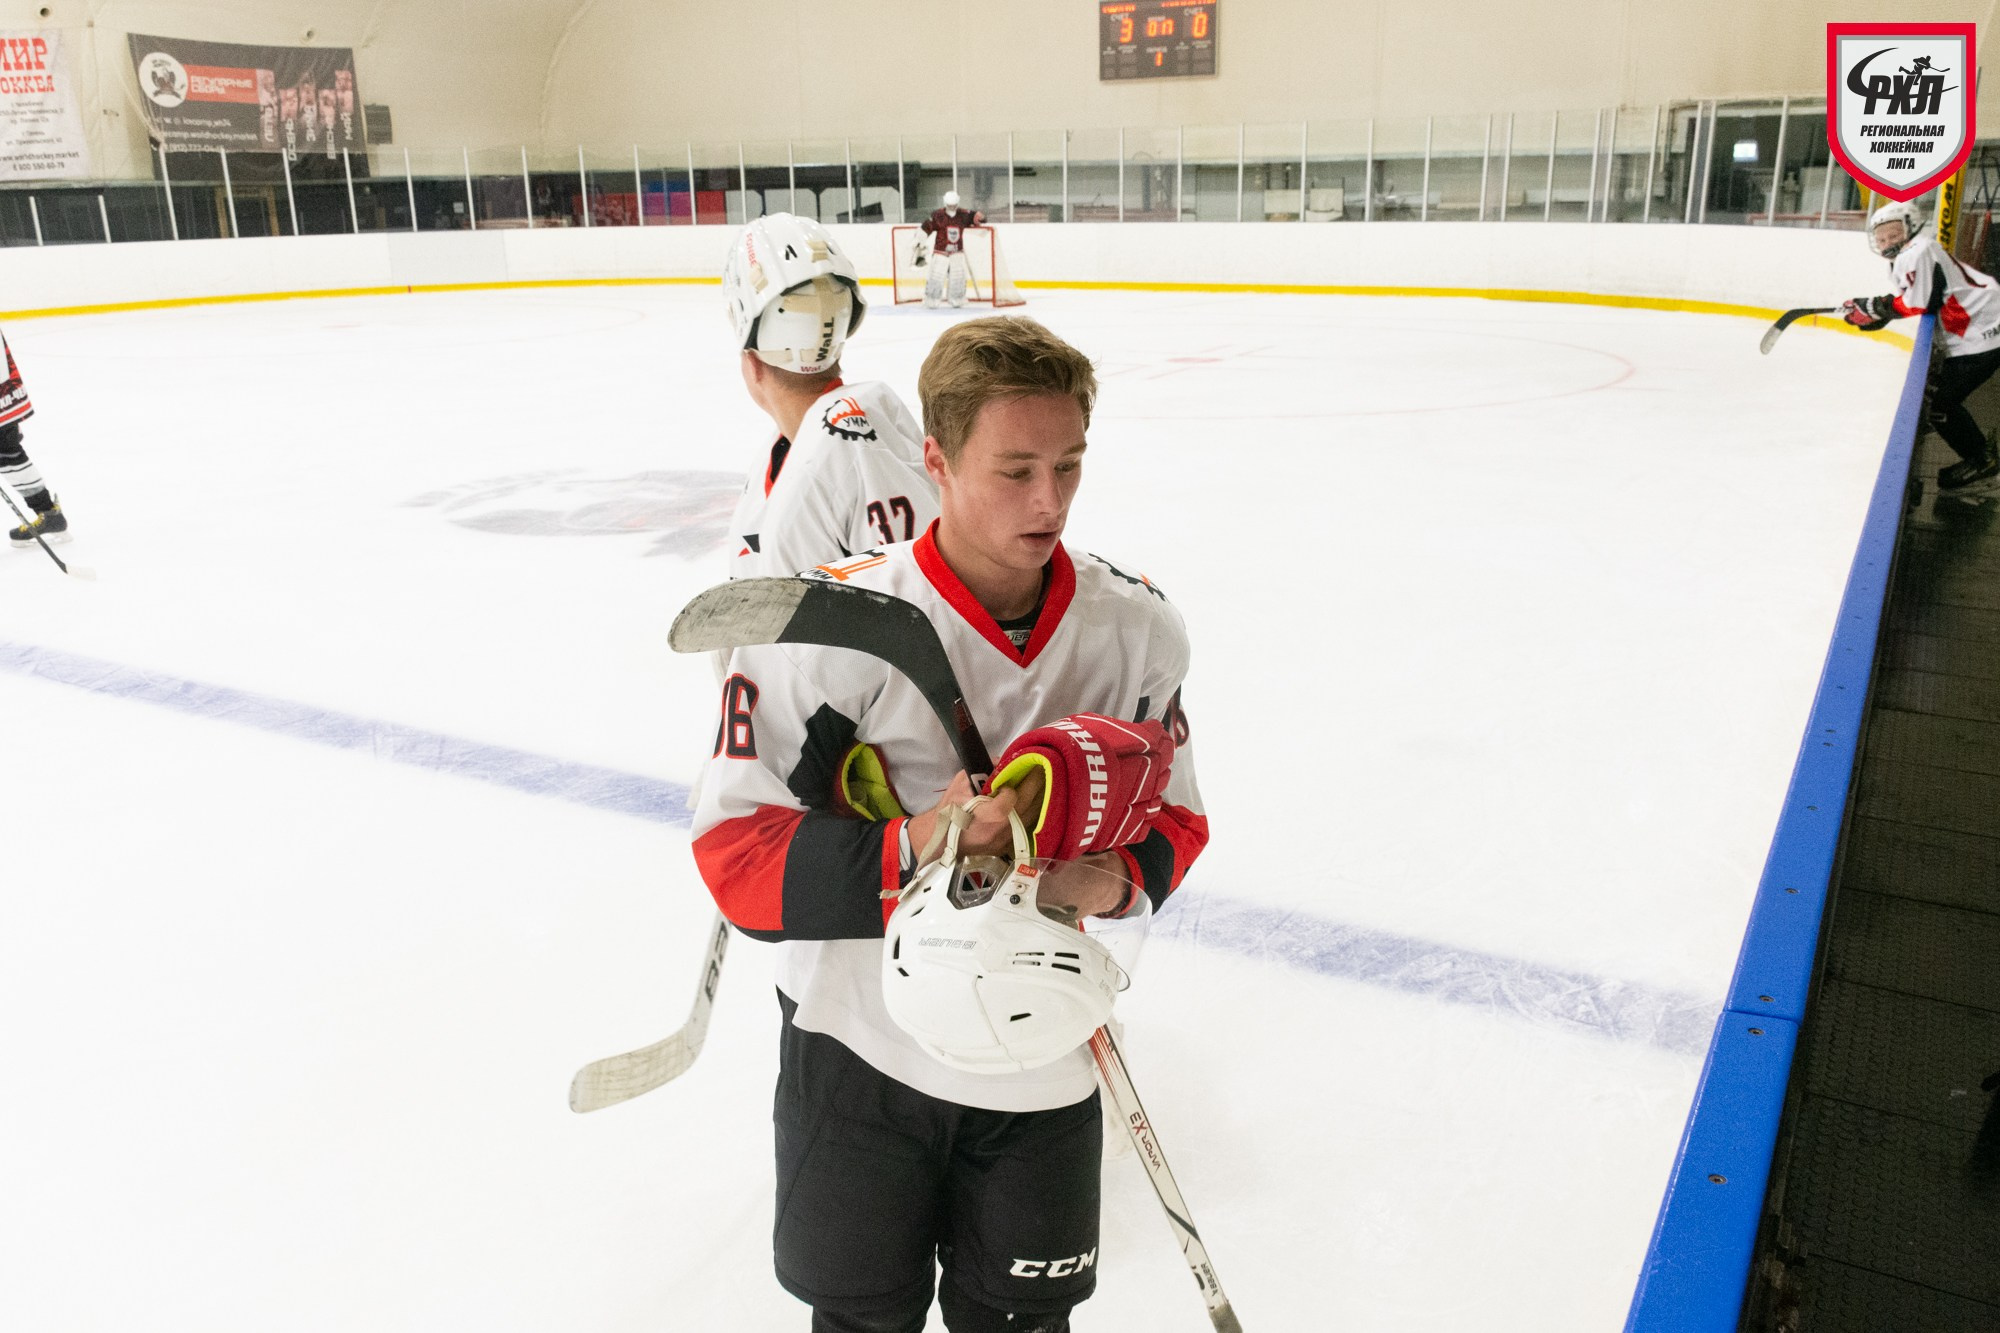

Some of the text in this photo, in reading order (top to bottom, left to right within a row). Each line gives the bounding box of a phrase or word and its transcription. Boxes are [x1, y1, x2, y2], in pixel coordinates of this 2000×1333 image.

[1119, 17, 1134, 43] 3
[1192, 11, 1208, 38] 0
[0, 75, 55, 94] ОККЕЯ
[918, 937, 977, 950] BAUER
[1009, 1246, 1097, 1278] CCM
